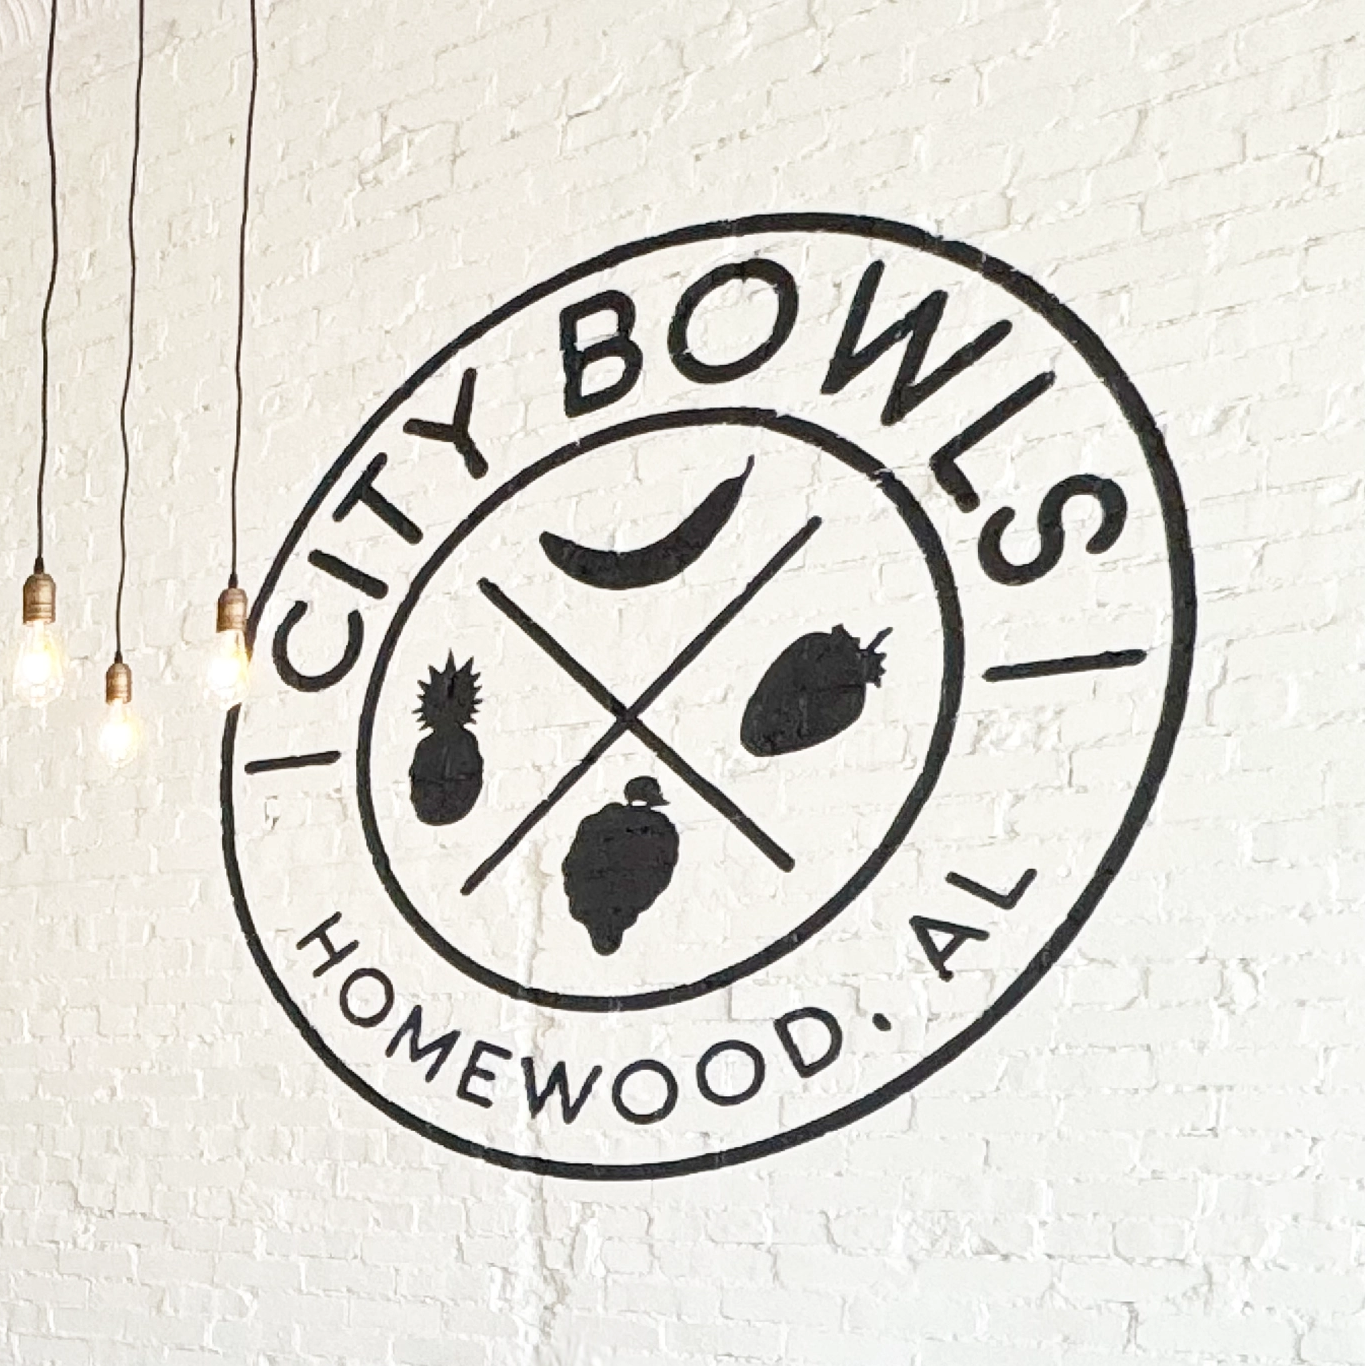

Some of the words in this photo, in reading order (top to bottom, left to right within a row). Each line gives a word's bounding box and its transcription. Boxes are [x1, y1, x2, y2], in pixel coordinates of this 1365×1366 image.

[272, 366, 487, 692] CITY
[557, 257, 1128, 588] BOWLS
[909, 866, 1039, 981] AL
